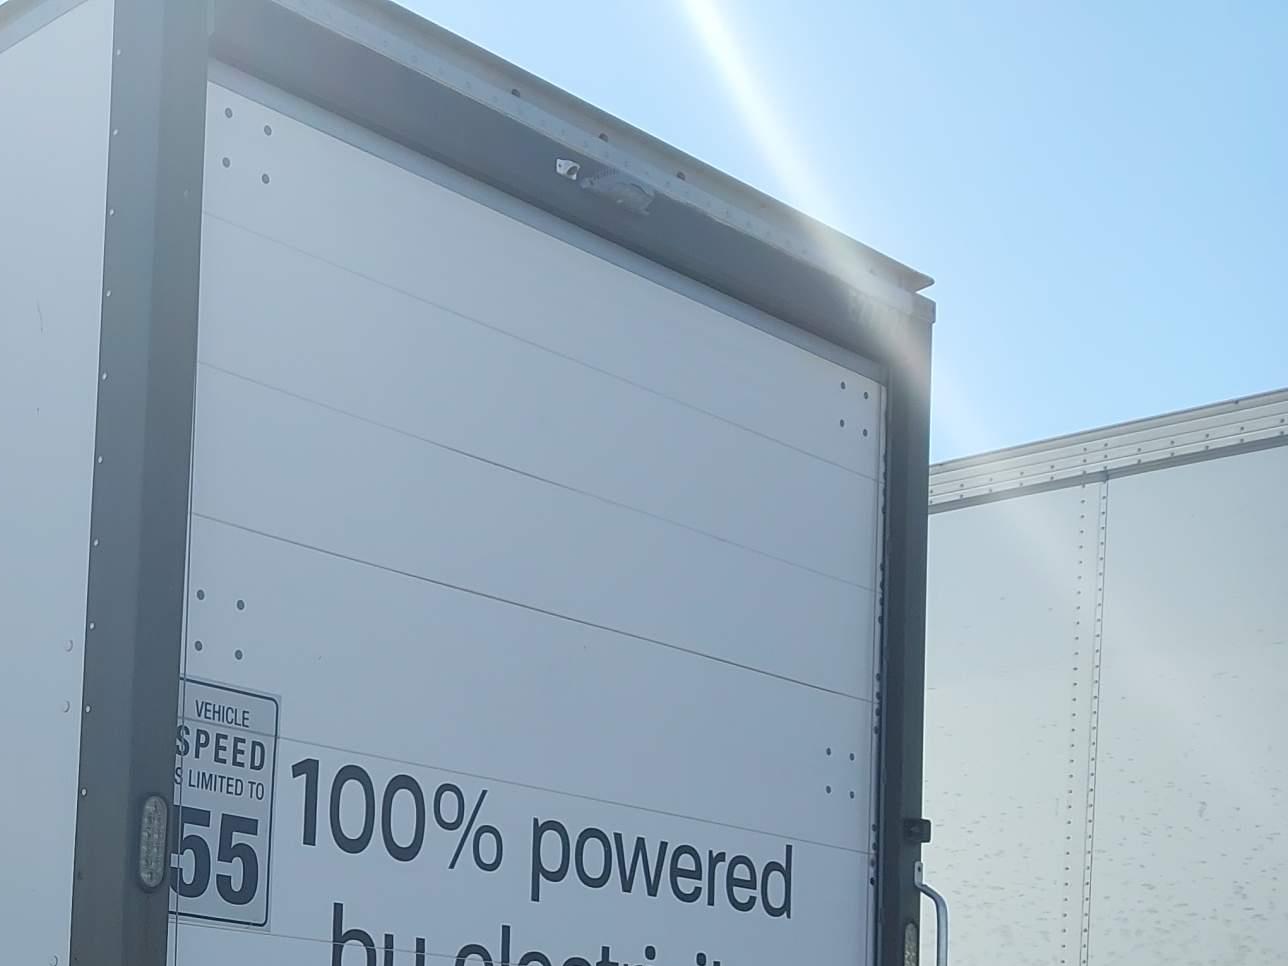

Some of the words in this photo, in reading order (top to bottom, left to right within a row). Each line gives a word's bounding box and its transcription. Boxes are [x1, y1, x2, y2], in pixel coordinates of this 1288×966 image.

[195, 700, 250, 727] VEHICLE
[176, 725, 266, 770] SPEED
[188, 768, 244, 797] LIMITED
[248, 780, 265, 801] TO
[170, 805, 259, 906] 55
[291, 758, 504, 873] 100%
[530, 816, 793, 919] powered
